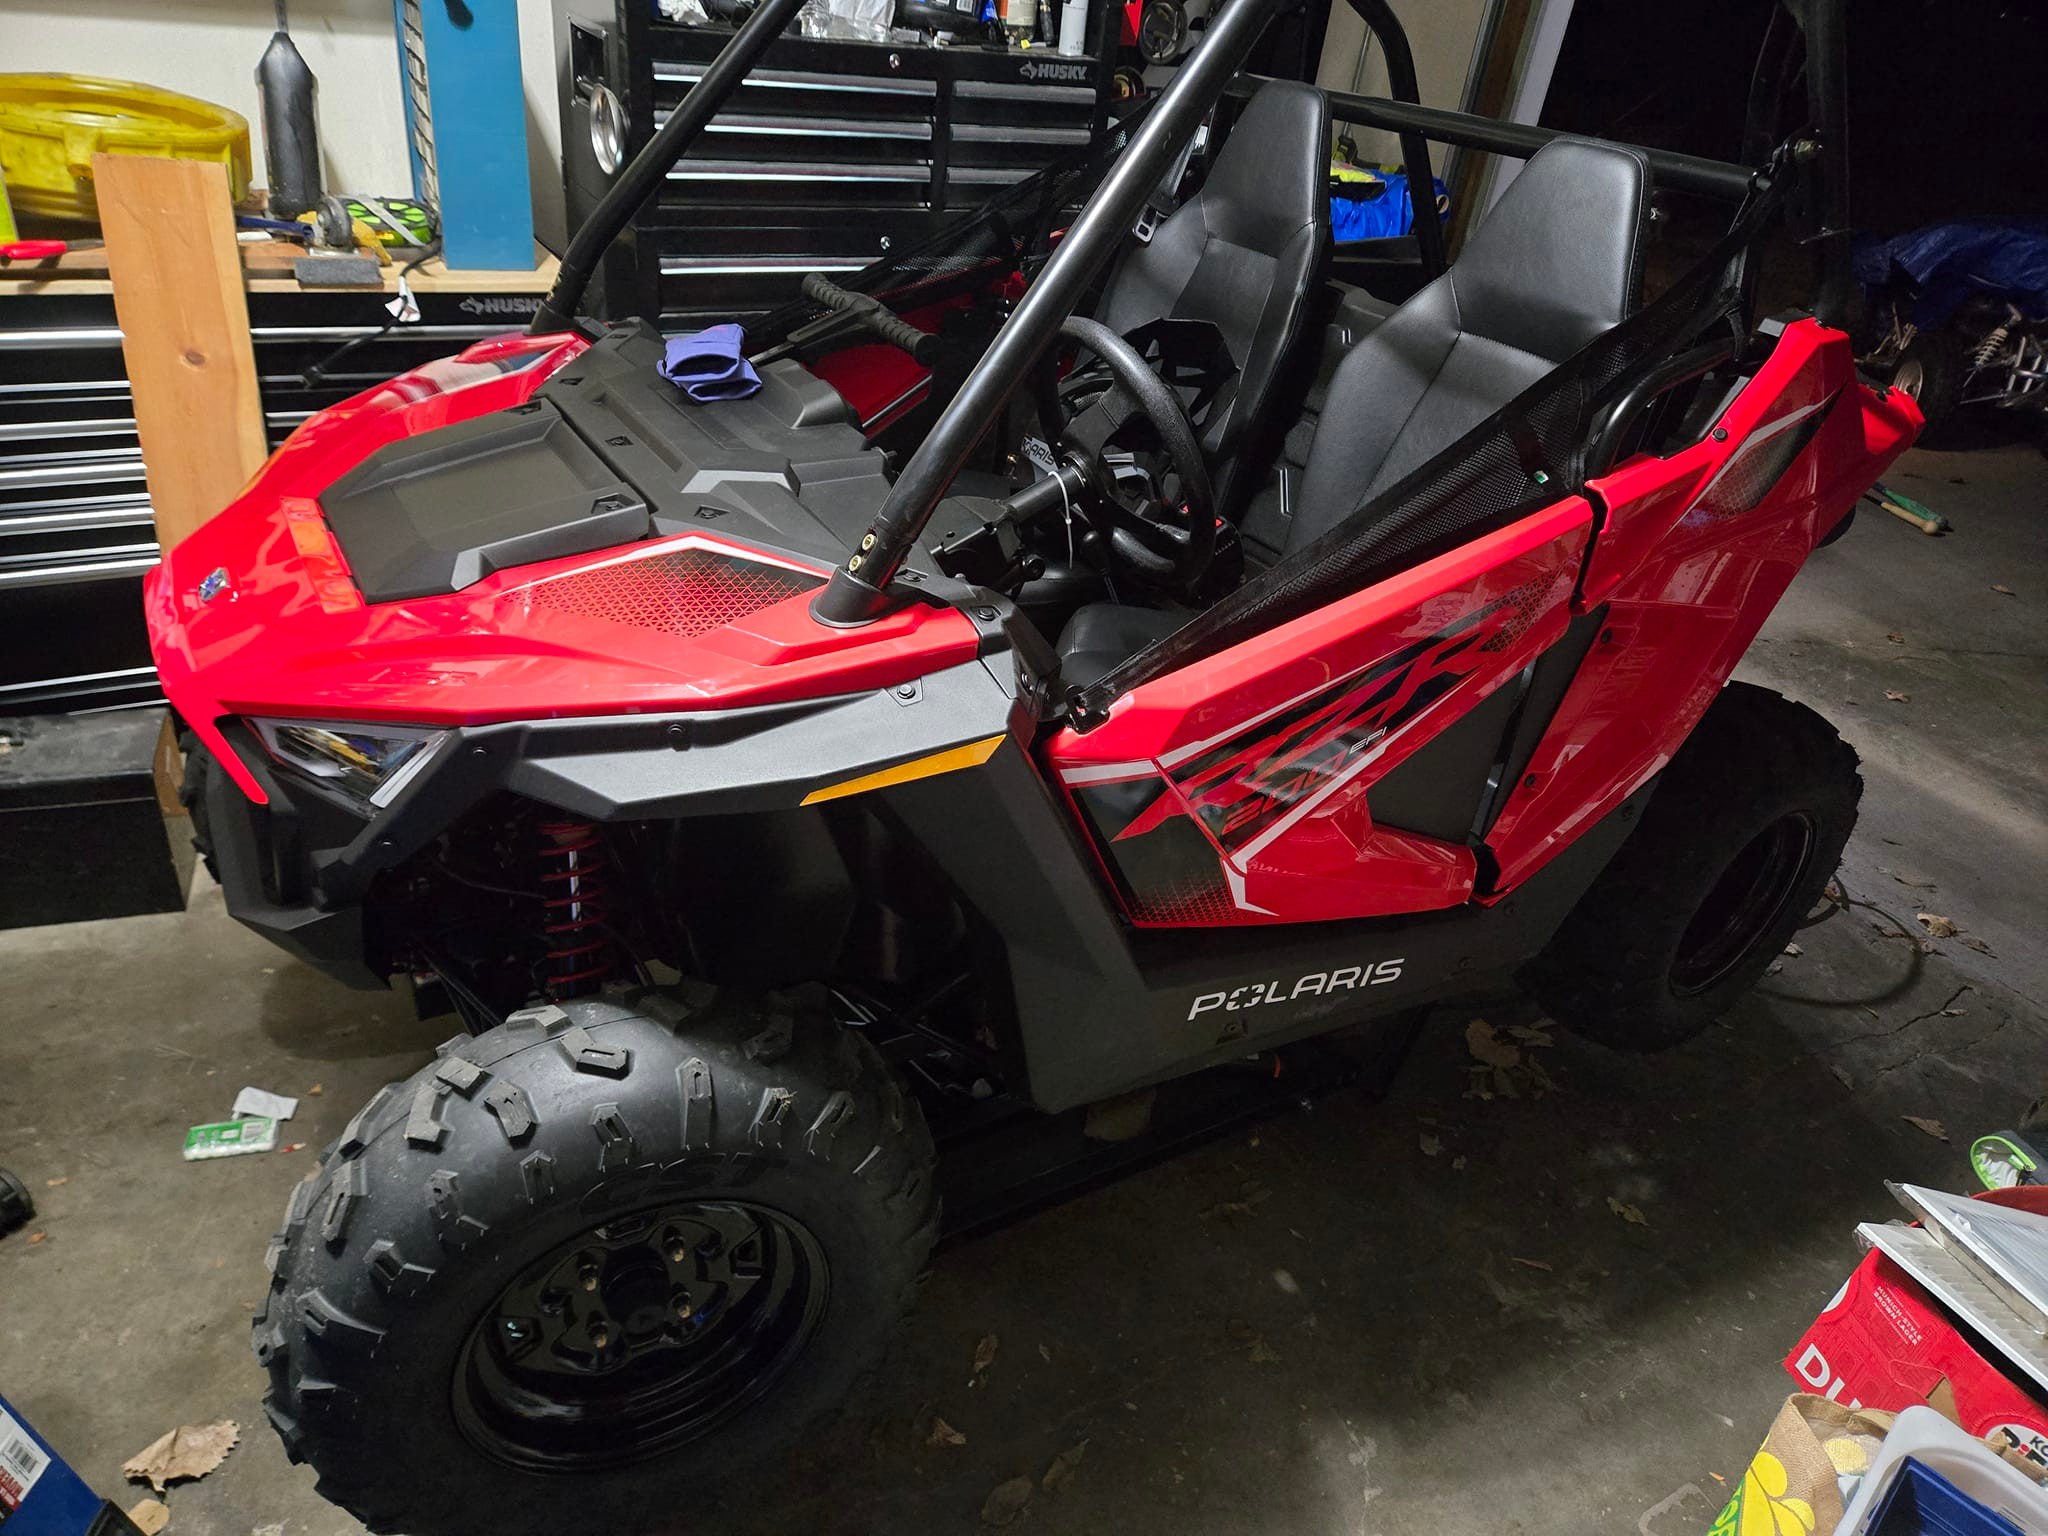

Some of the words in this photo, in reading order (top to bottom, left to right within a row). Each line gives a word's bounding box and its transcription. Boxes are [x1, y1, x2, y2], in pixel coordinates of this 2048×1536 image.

[1038, 63, 1088, 80] HUSKY
[484, 297, 542, 314] HUSK
[1349, 726, 1387, 755] EFI
[1187, 958, 1405, 1021] POLARIS
[1873, 1291, 1897, 1320] BROWN
[1896, 1320, 1918, 1346] LAGER
[1877, 1286, 1923, 1341] MUNICH-STYLE
